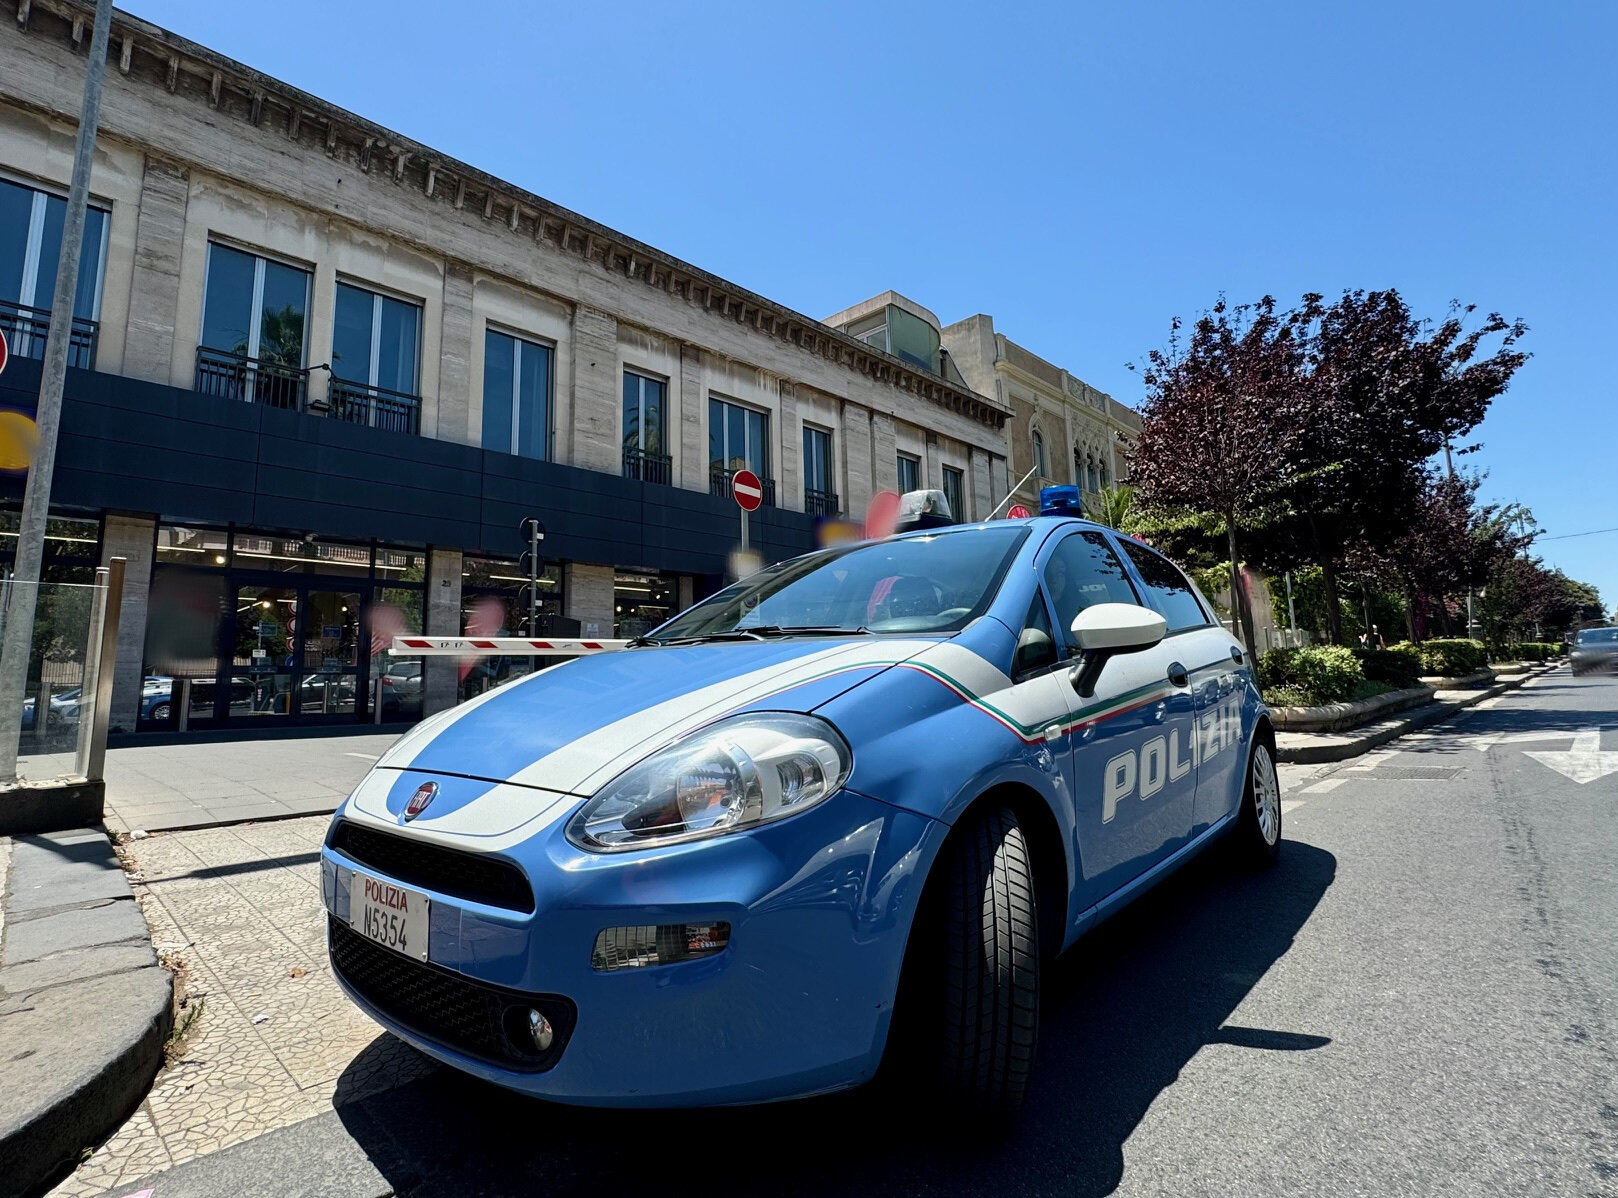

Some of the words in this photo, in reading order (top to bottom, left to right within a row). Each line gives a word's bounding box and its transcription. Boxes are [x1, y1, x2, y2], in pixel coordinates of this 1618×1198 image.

[1102, 699, 1243, 824] POLIZIA
[364, 878, 409, 914] POLIZIA
[363, 903, 408, 952] N5354
